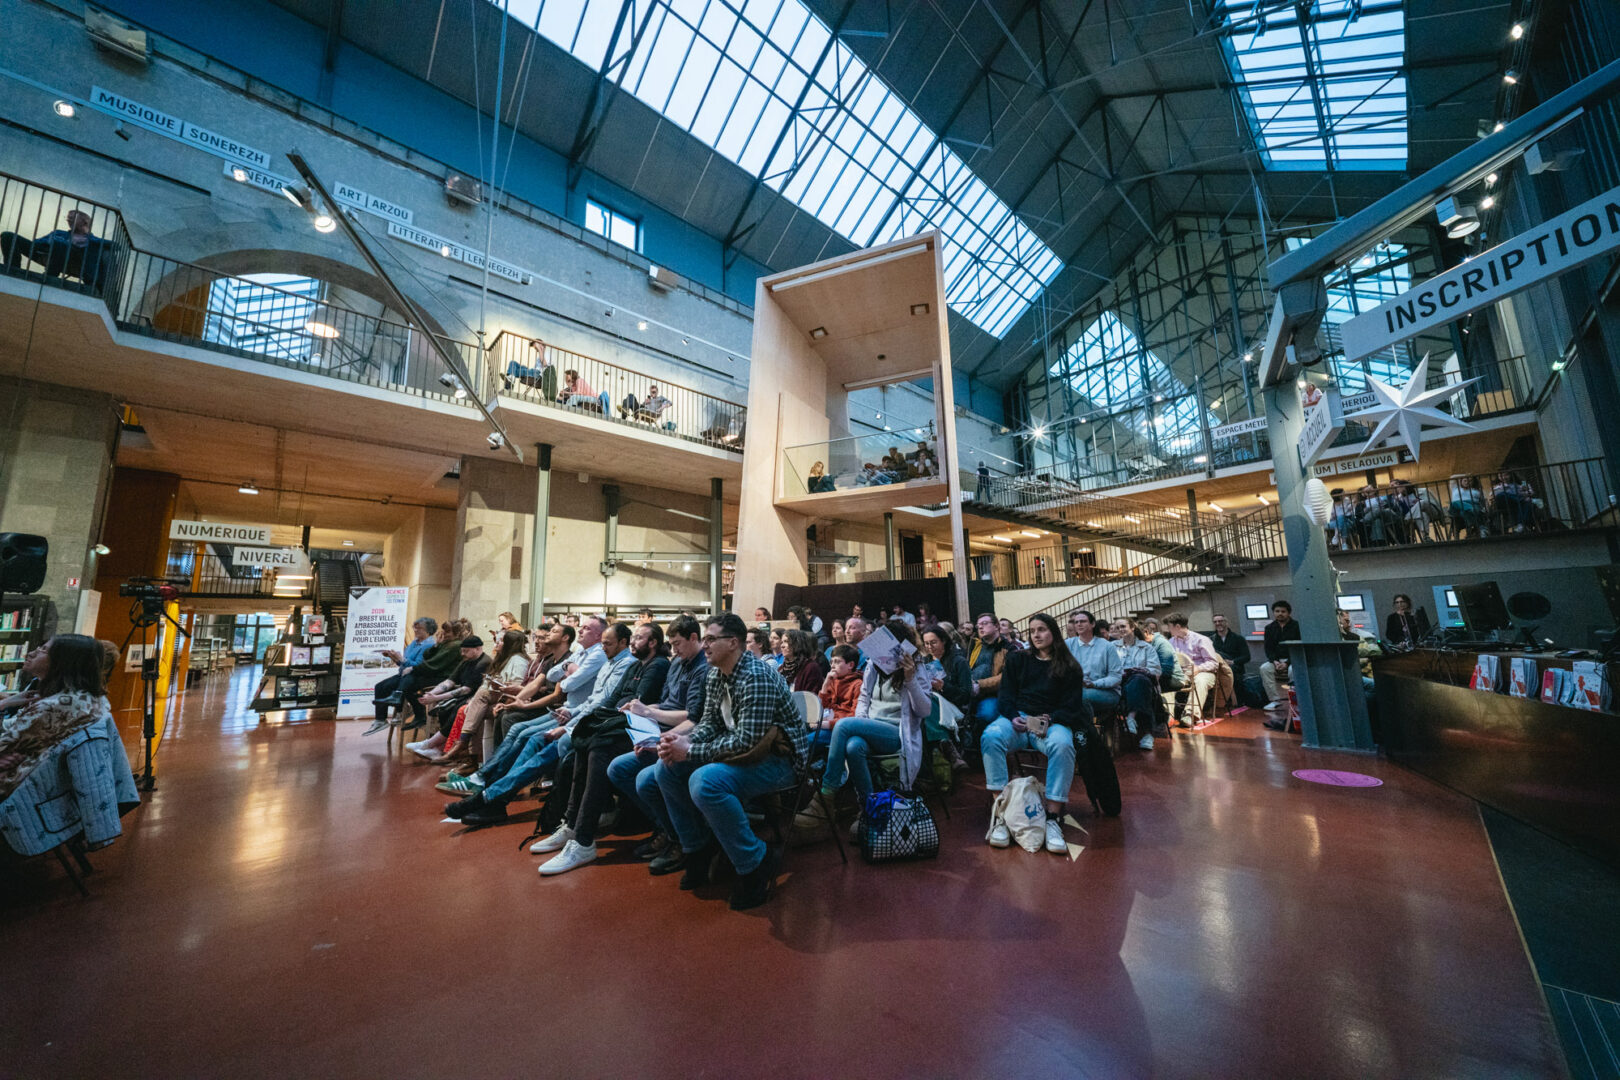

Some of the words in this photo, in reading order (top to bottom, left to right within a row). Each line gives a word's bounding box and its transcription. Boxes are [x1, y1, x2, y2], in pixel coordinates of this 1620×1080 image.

[100, 92, 175, 130] MUSIQUE
[189, 127, 265, 165] SONEREZH
[230, 164, 283, 192] CNEMA
[339, 187, 362, 201] ART
[372, 199, 409, 220] ARZOU
[1216, 424, 1244, 437] ESPACE
[1340, 454, 1394, 471] SELAOUVA
[239, 550, 296, 564] NIVEREL
[354, 621, 398, 629] AMBASSADRICE
[367, 628, 396, 636] SCIENCES
